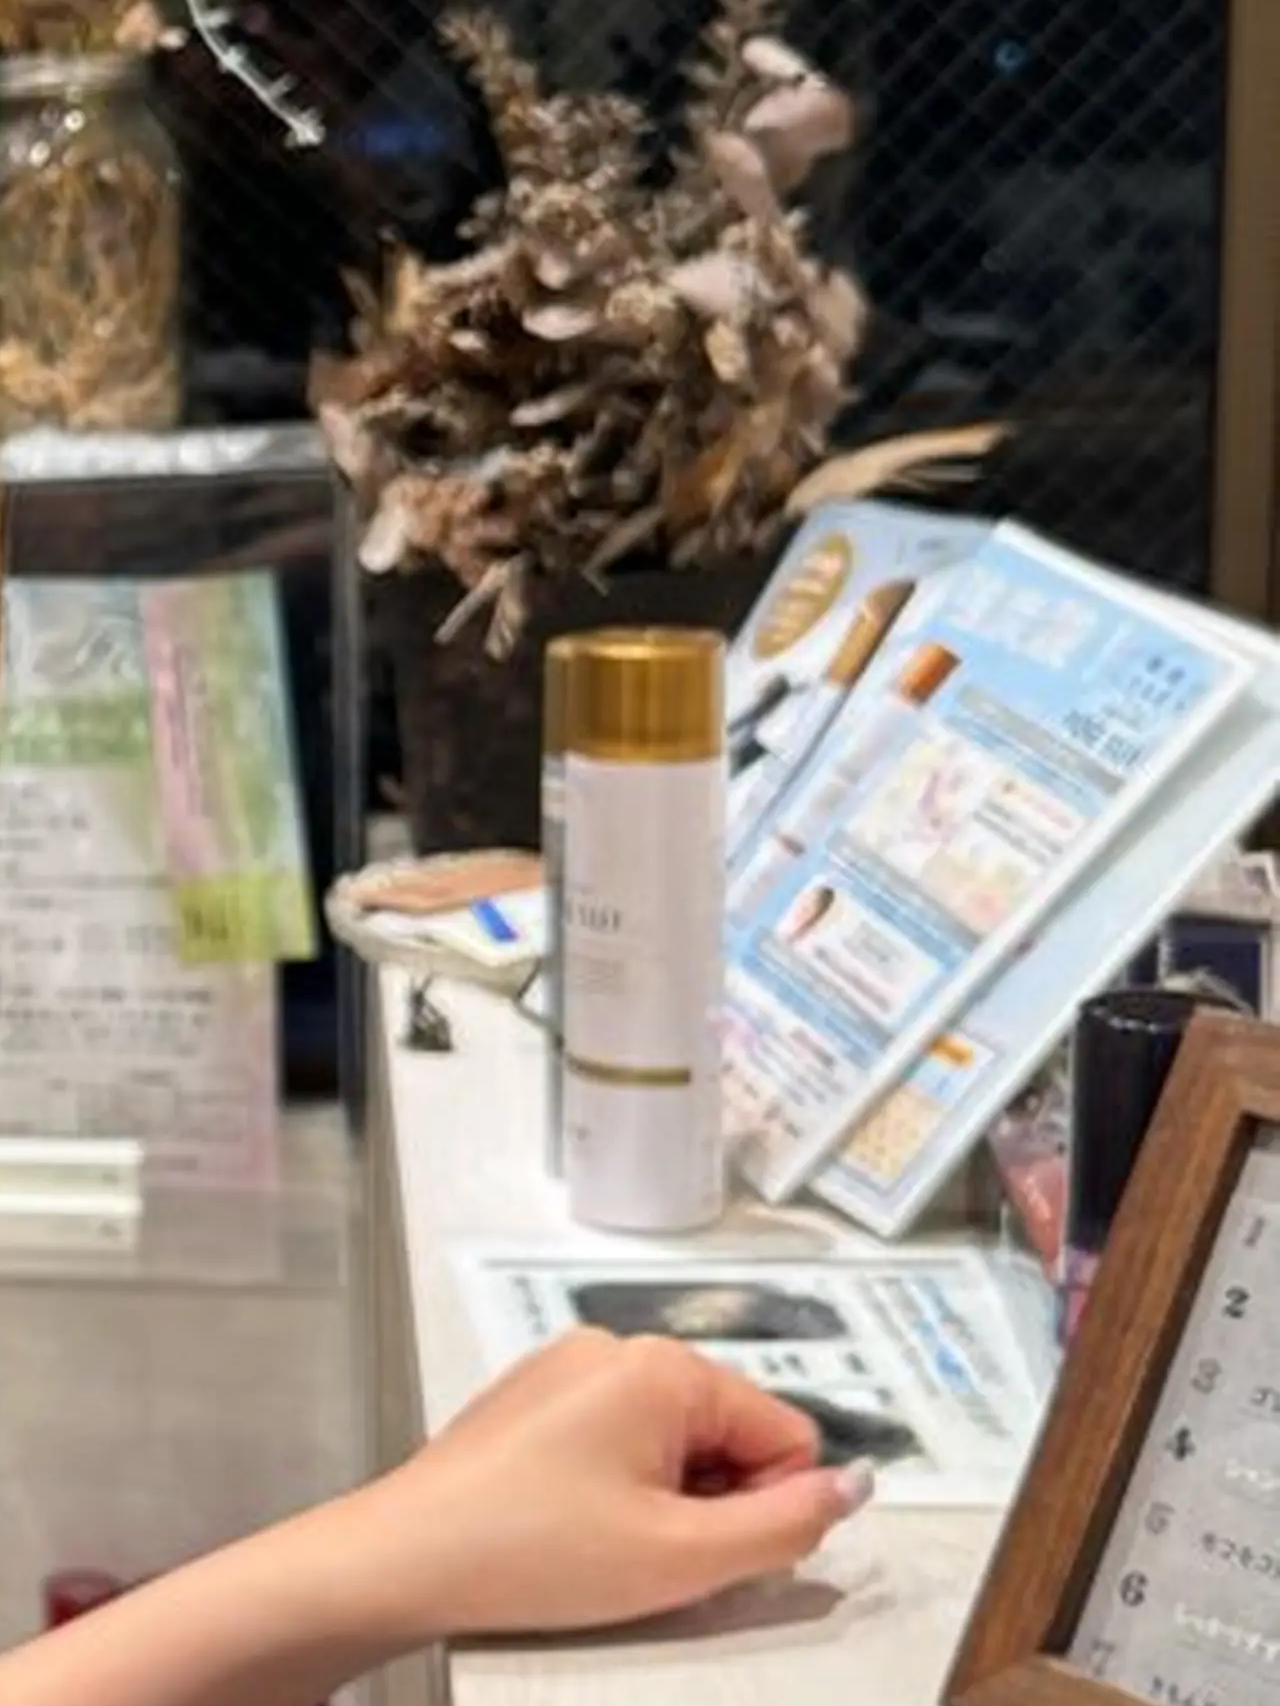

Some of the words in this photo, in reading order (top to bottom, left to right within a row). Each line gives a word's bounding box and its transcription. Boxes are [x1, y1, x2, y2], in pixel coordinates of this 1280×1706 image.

[1223, 1286, 1250, 1319] 2
[1192, 1358, 1222, 1395] 3
[1167, 1427, 1195, 1461] 4
[1146, 1502, 1175, 1534] 5
[1120, 1570, 1148, 1607] 6
[1092, 1638, 1115, 1677] 7
